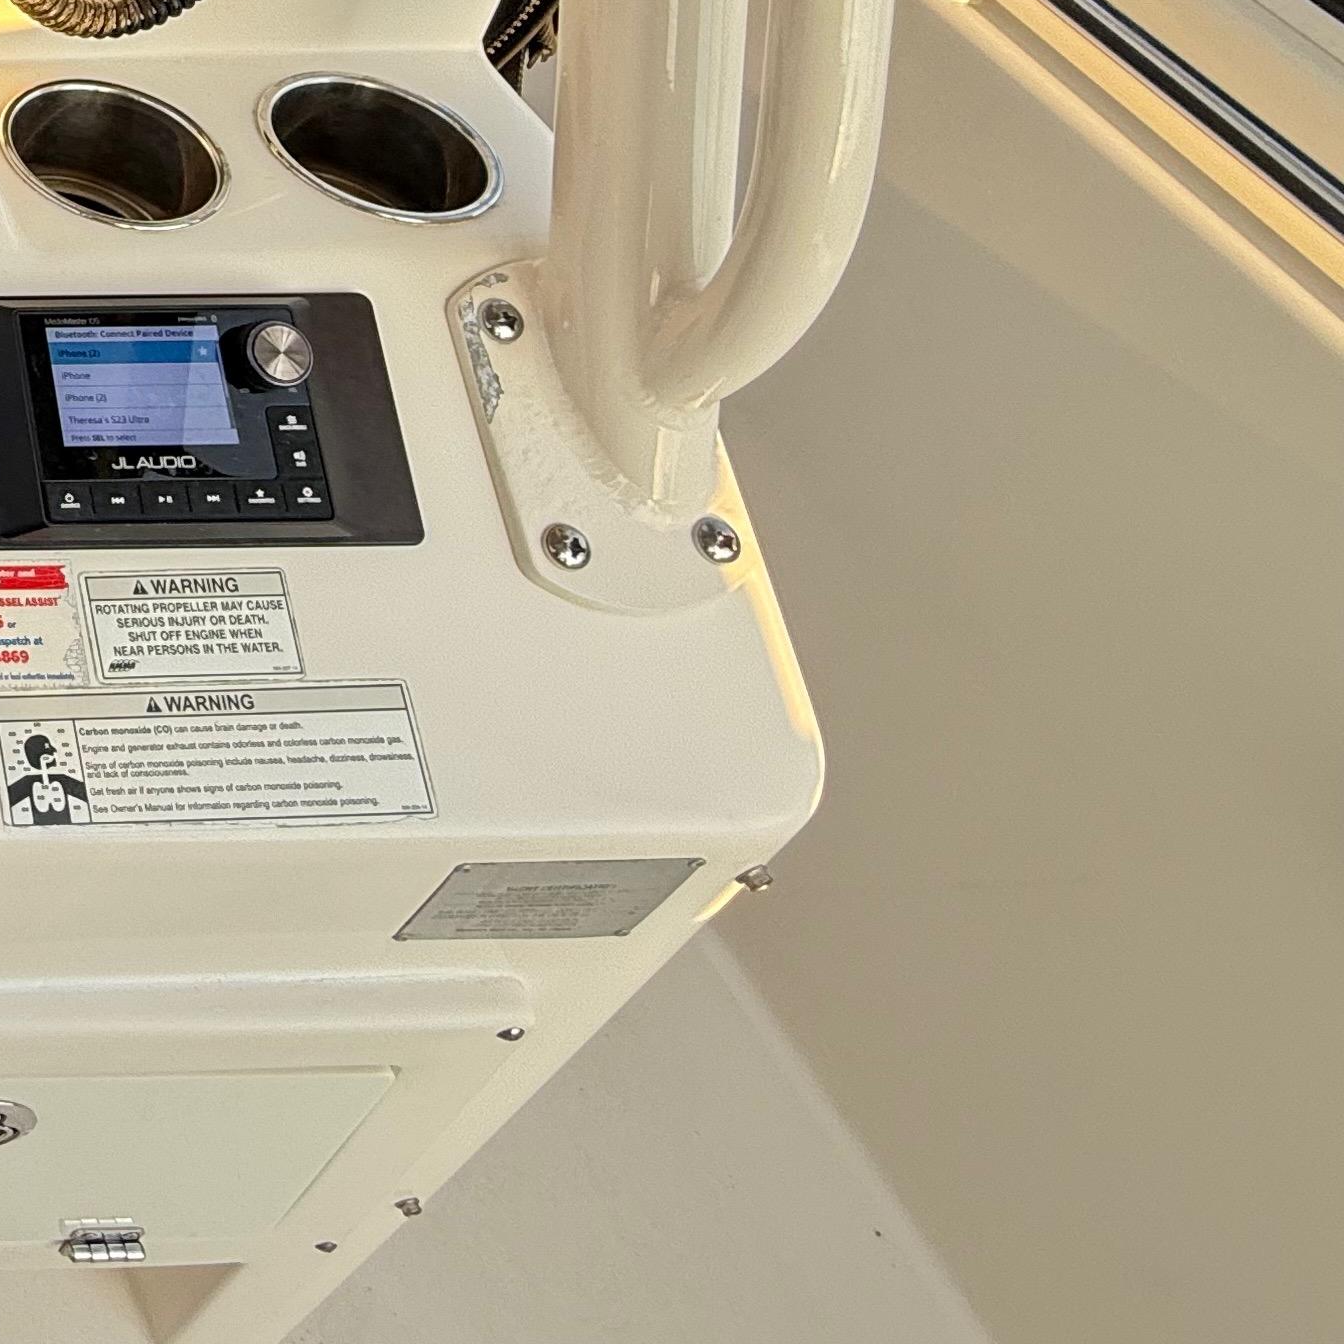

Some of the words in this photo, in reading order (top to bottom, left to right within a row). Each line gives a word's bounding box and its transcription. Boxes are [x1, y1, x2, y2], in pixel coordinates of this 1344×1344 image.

[96, 394, 107, 402] (2)
[111, 416, 127, 424] S23
[112, 456, 134, 469] JL
[137, 456, 196, 468] AUDIO
[151, 578, 239, 594] WARNING
[25, 598, 58, 606] ASSIST
[95, 603, 149, 615] ROTATING
[153, 602, 218, 612] PROPELLER
[221, 601, 242, 611] MAY
[245, 600, 283, 610] CAUSE
[8, 621, 16, 629] or
[117, 617, 165, 628] SERIOUS
[168, 616, 206, 627] INJURY
[210, 616, 225, 625] OR
[229, 615, 269, 625] DEATH.
[128, 631, 157, 641] SHUT
[161, 631, 182, 641] OFF
[186, 630, 226, 640] ENGINE
[230, 629, 262, 639] WHEN
[114, 646, 144, 656] NEAR
[148, 645, 200, 655] PERSONS
[204, 645, 214, 654] IN
[217, 644, 238, 653] THE
[241, 642, 283, 653] WATER.
[163, 694, 255, 712] WARNING
[79, 727, 109, 735] Carbon
[112, 726, 151, 734] monoxide
[154, 725, 172, 735] (CO)
[215, 722, 233, 731] brain
[82, 745, 108, 754] Engine
[111, 744, 125, 752] and
[128, 744, 163, 753] generator
[267, 739, 281, 747] and
[86, 762, 107, 770] Signs
[109, 761, 117, 769] of
[187, 759, 223, 768] poisoning
[90, 788, 103, 796] Get
[106, 787, 125, 795] fresh
[147, 787, 174, 795] anyone
[204, 785, 223, 793] signs
[226, 784, 233, 792] of
[236, 783, 262, 791] carbon
[264, 782, 301, 790] monoxide
[111, 804, 143, 812] Owner's
[188, 802, 231, 810] information
